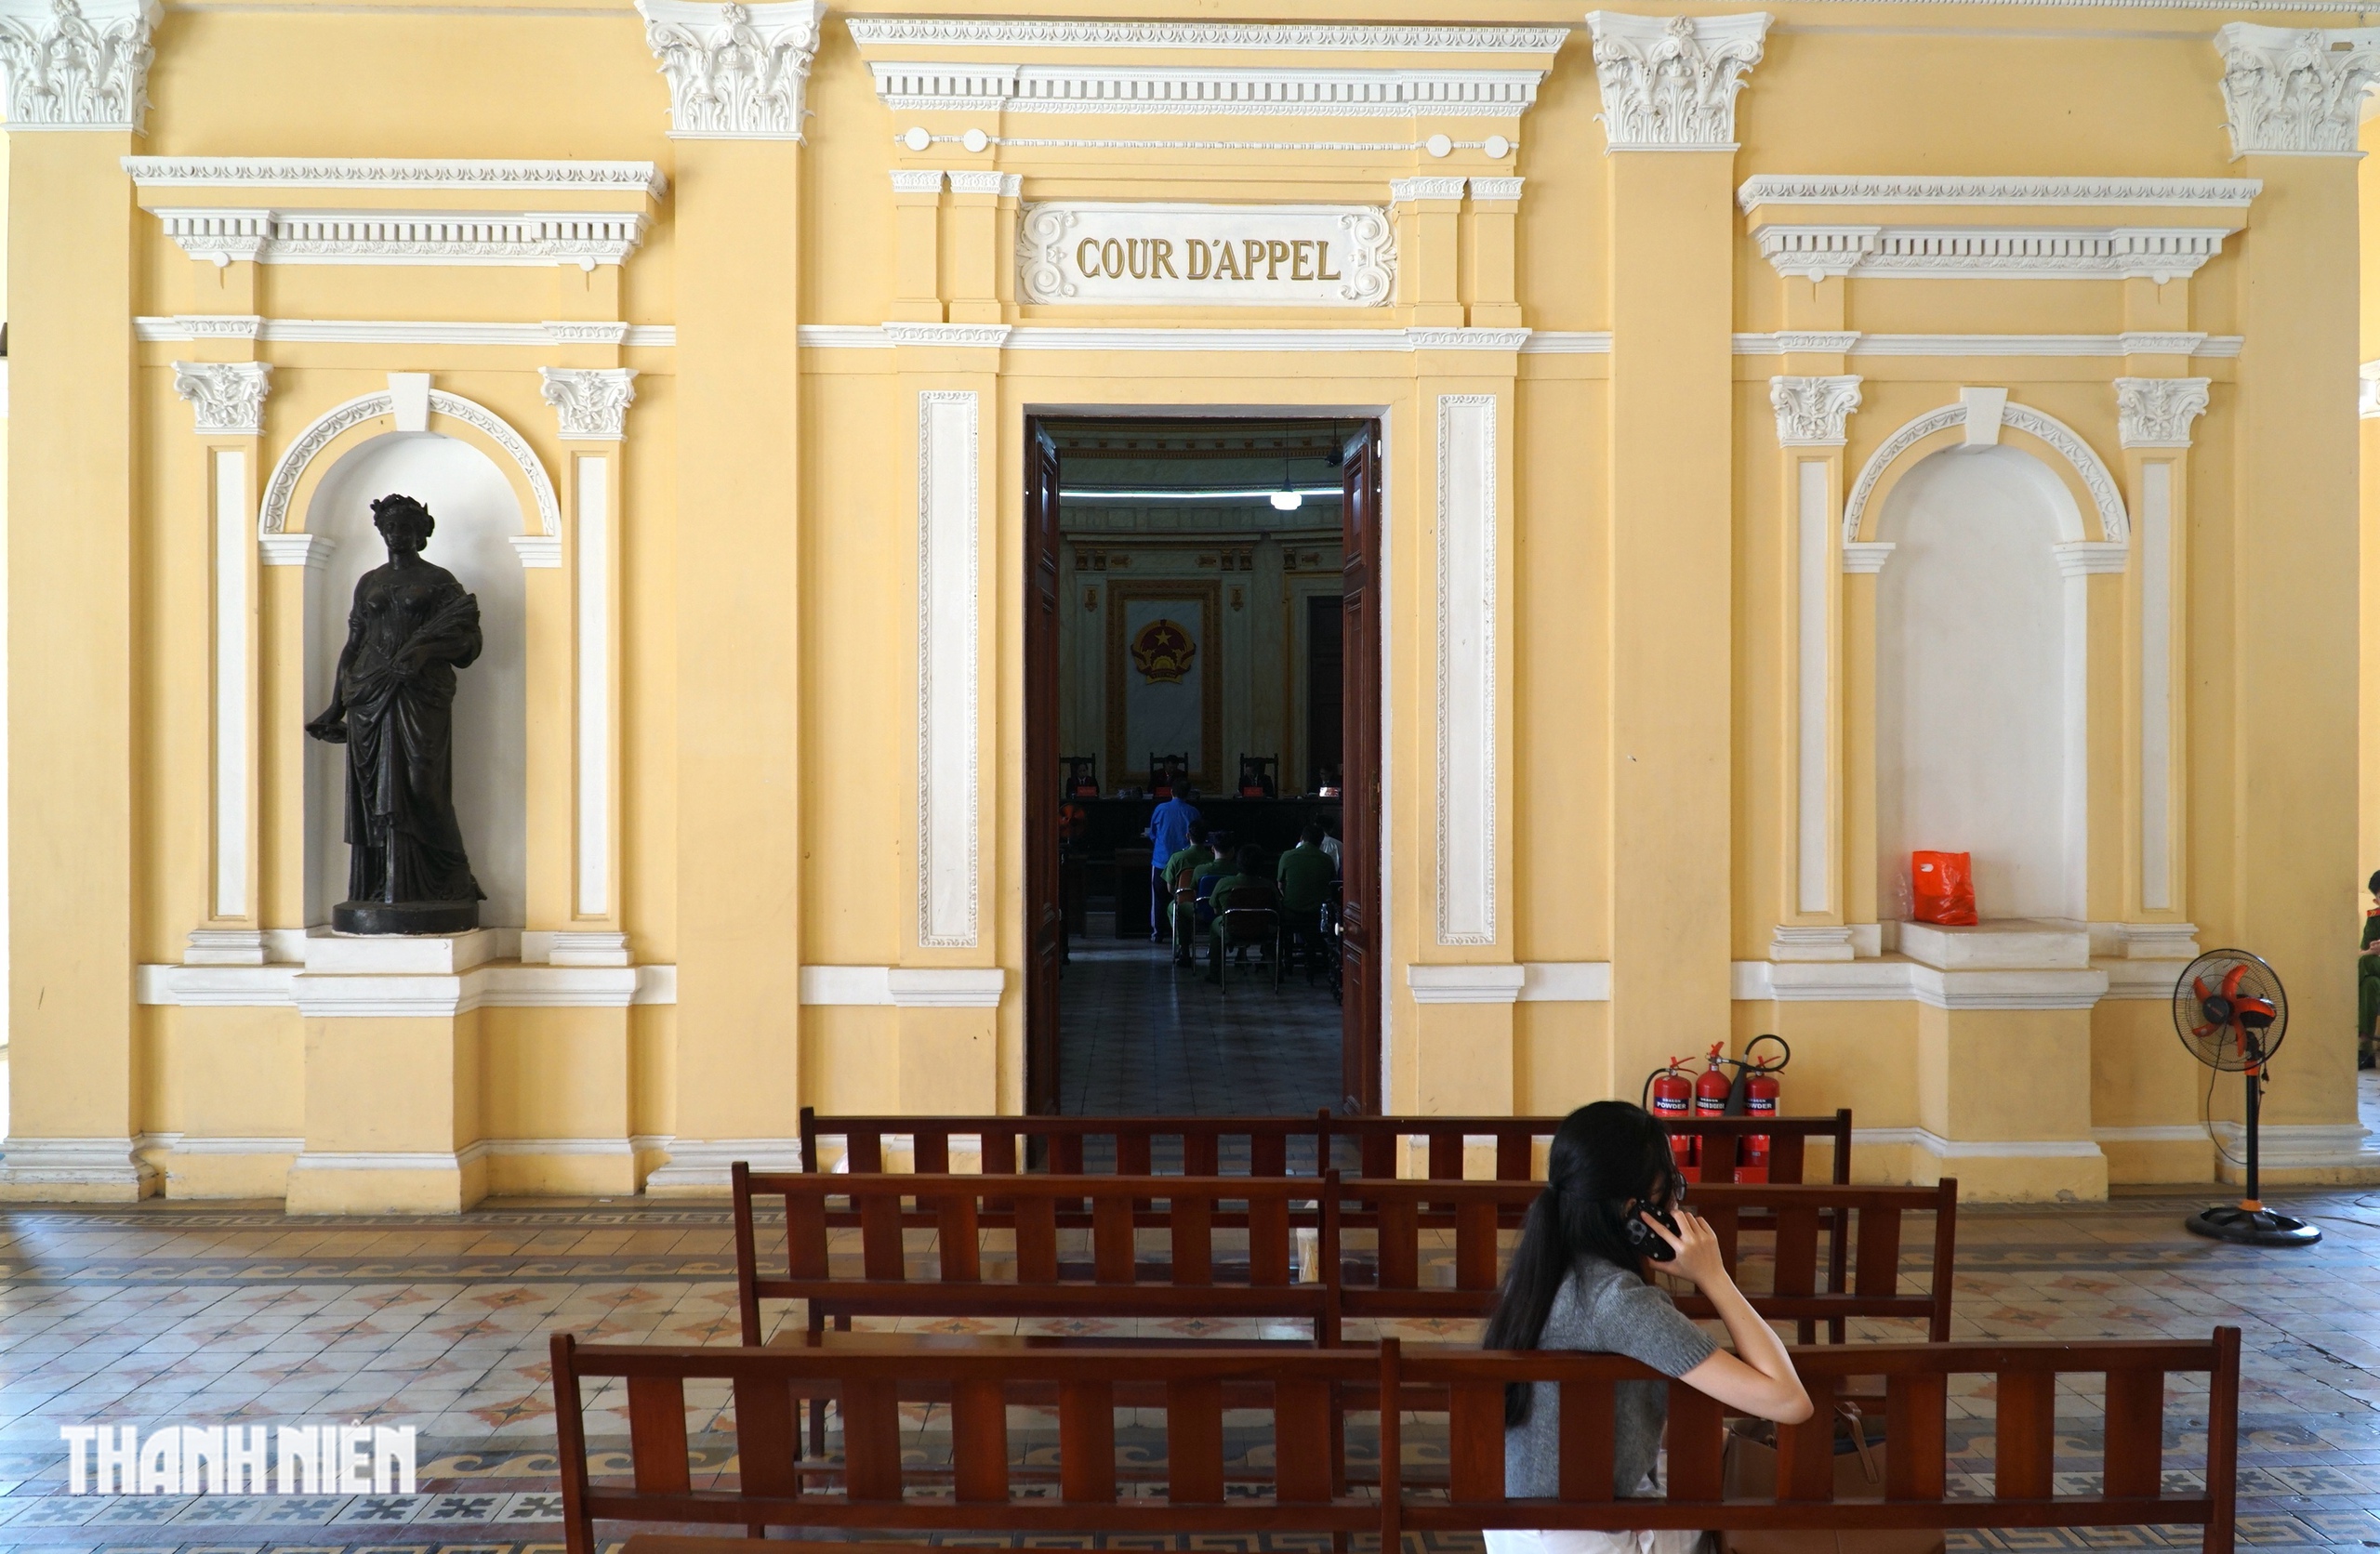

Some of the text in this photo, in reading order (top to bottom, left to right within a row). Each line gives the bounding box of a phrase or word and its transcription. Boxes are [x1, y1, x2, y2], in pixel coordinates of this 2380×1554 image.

[1076, 237, 1342, 282] COUR D'APPEL
[1657, 1101, 1686, 1110] POWDER
